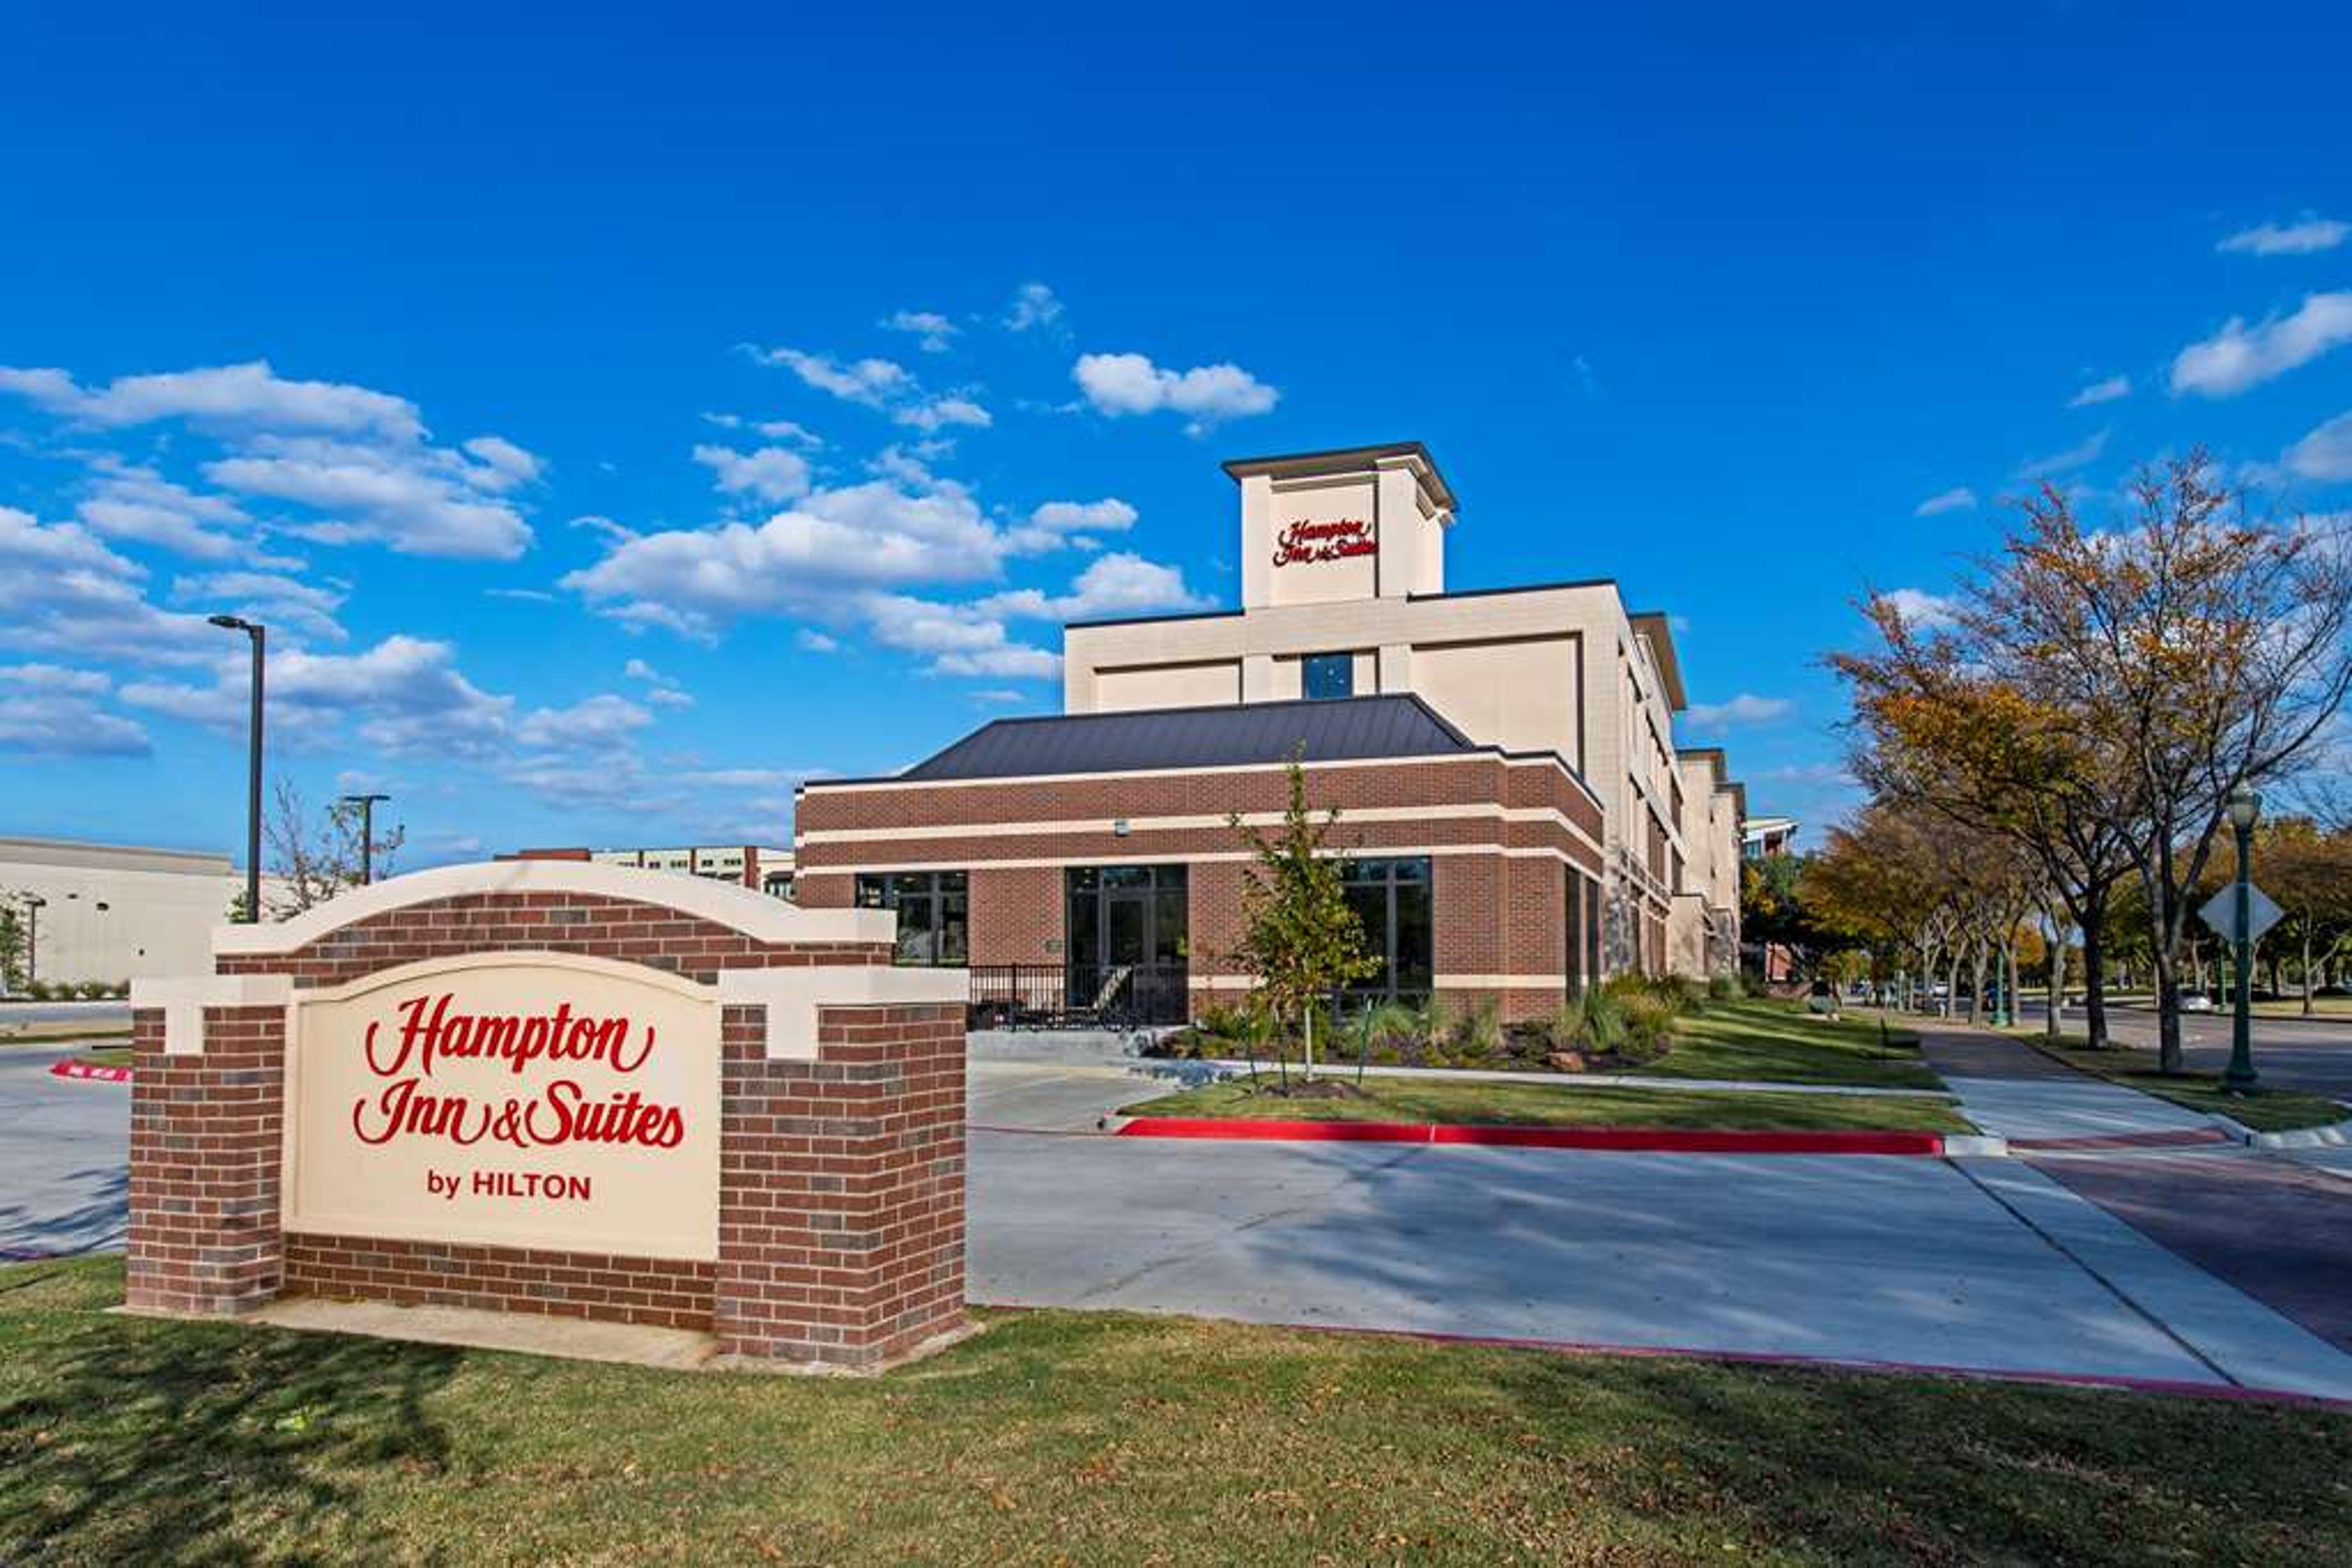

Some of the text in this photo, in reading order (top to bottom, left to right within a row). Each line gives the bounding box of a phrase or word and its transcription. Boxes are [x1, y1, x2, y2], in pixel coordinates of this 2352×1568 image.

[1278, 519, 1371, 546] Hampton
[1273, 545, 1317, 567] Inn
[366, 993, 655, 1076] Hampton
[353, 1078, 685, 1150] Inn & Suites
[428, 1170, 590, 1200] by HILTON
